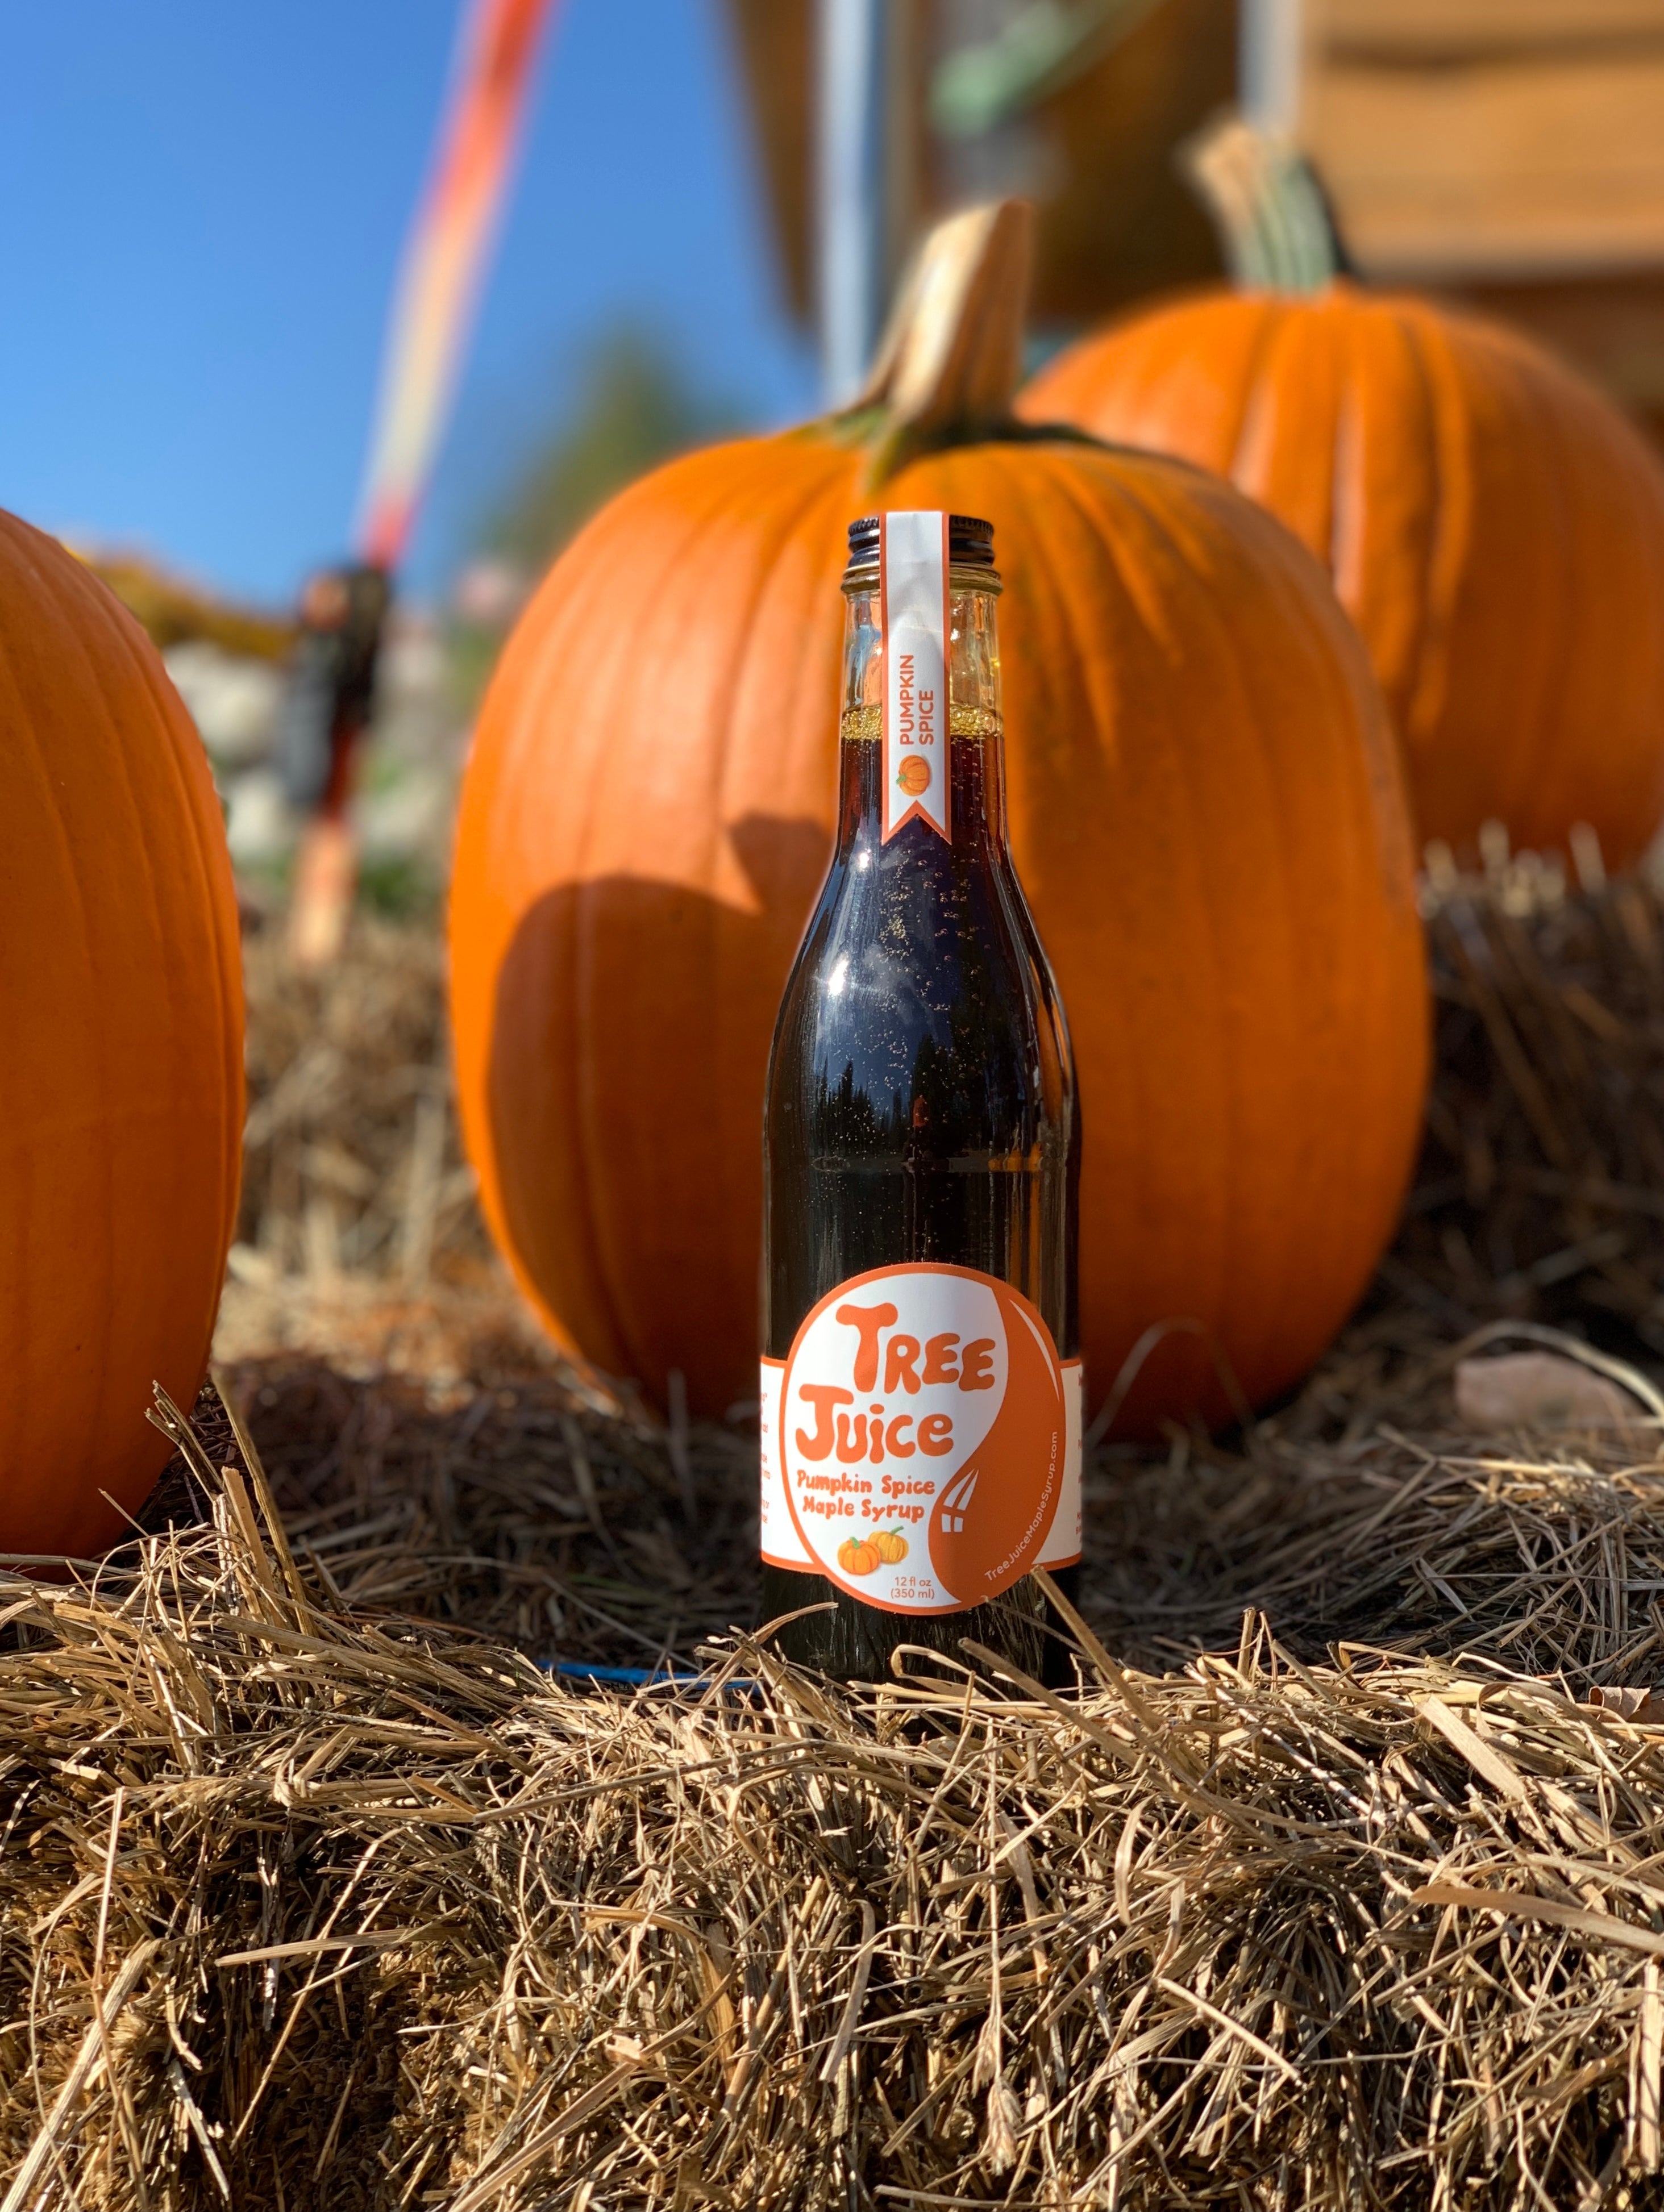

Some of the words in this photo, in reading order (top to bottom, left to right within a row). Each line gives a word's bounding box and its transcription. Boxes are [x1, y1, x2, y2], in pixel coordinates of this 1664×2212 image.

[900, 655, 914, 745] PUMPKIN
[918, 689, 934, 745] SPICE
[835, 1302, 996, 1394] TREE
[796, 1384, 954, 1464] Juice
[797, 1469, 872, 1496] Pumpkin
[881, 1474, 935, 1499] Spice
[802, 1496, 855, 1519] Maple
[862, 1499, 925, 1523] Syrup
[984, 1431, 1058, 1581] TreeJuiceMapleSyrup.com
[891, 1588, 914, 1599] (350
[918, 1588, 935, 1599] ml)
[895, 1576, 907, 1586] 12
[909, 1576, 916, 1586] fl
